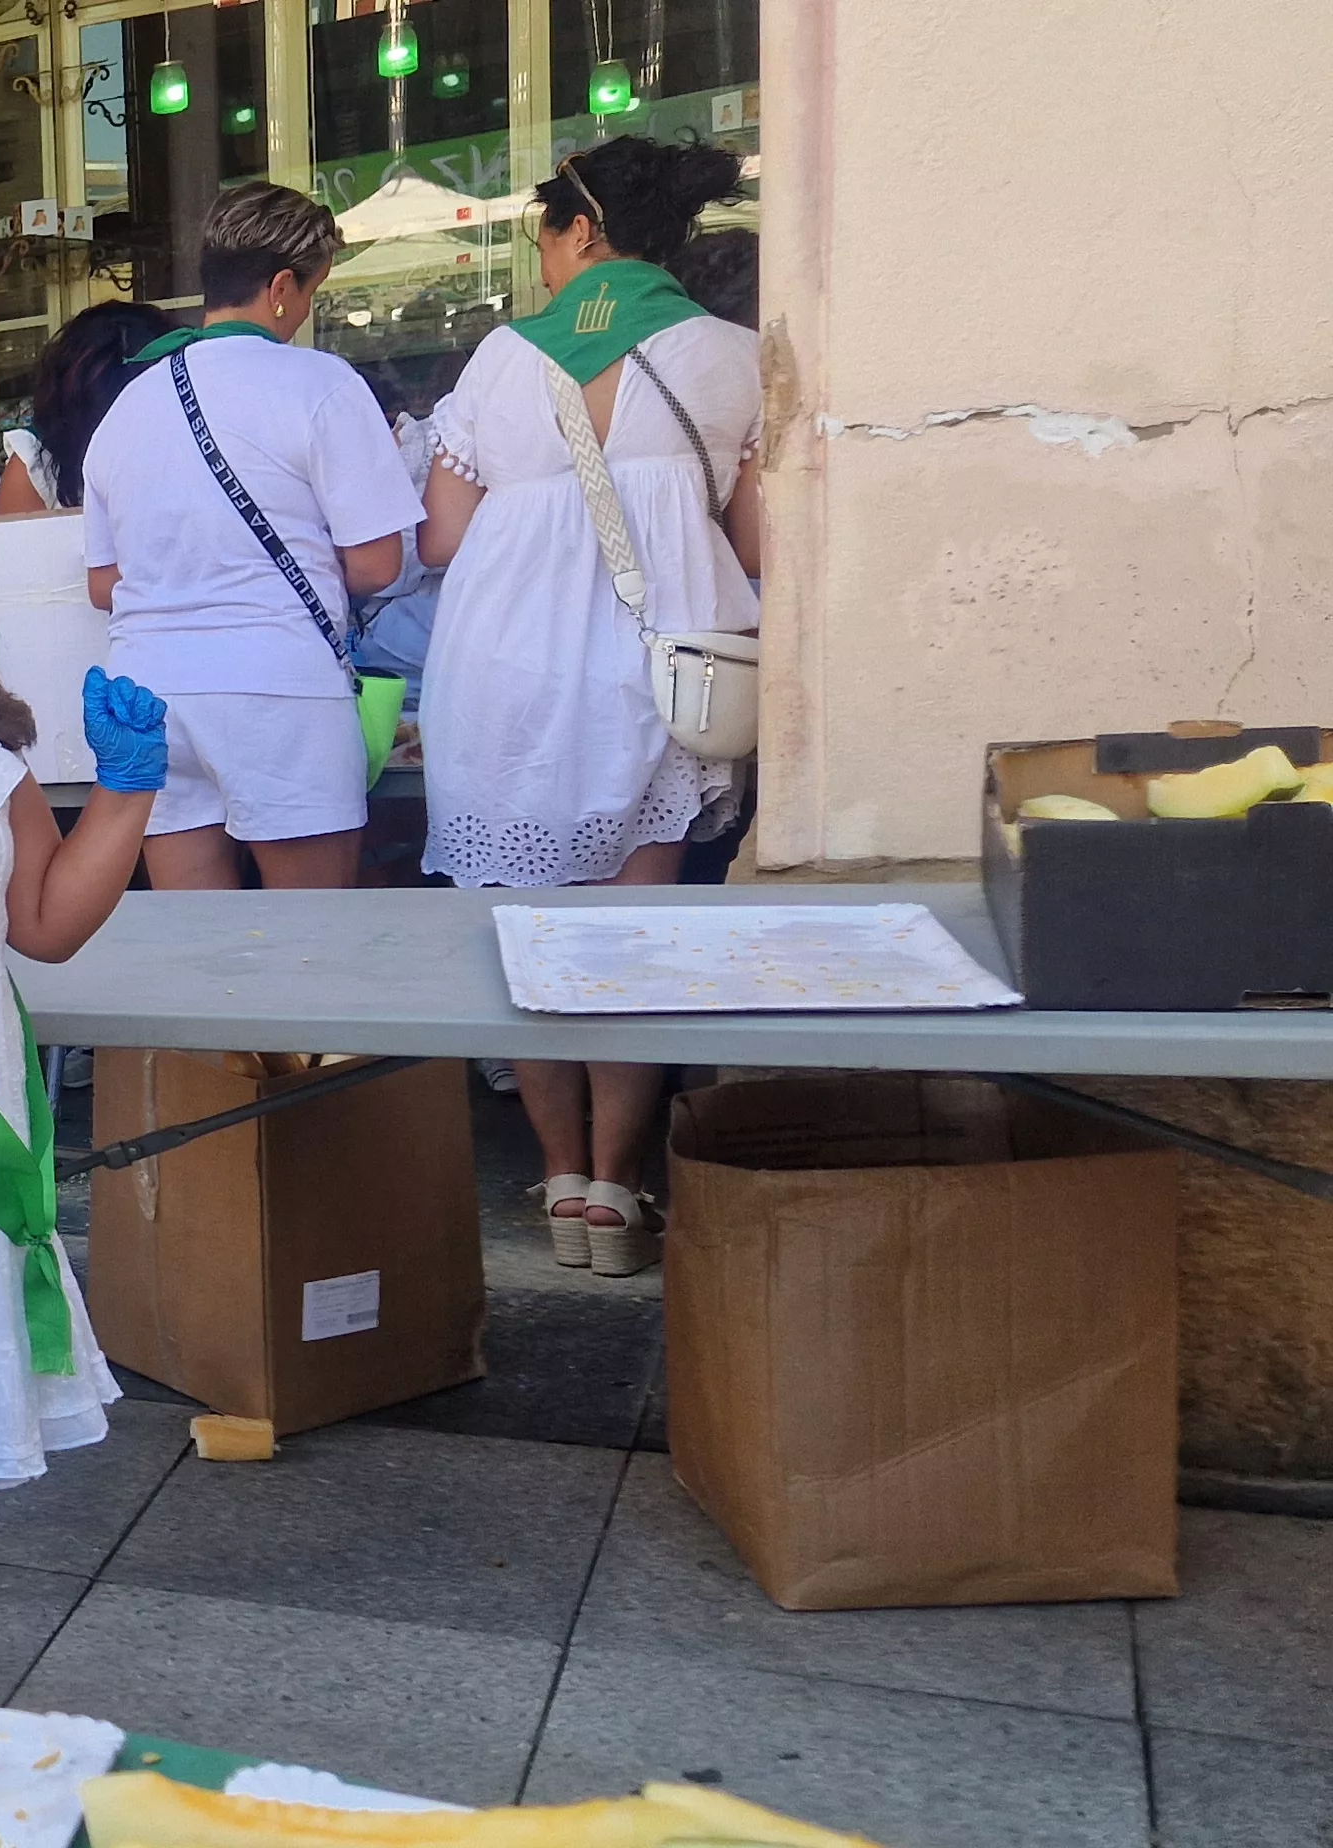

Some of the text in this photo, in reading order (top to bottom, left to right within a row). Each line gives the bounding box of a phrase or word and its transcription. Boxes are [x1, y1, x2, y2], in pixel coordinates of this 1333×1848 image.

[171, 354, 197, 413] FLEURS
[191, 415, 215, 454] DES
[211, 459, 252, 510] FILLE
[251, 513, 274, 541] LA
[277, 552, 333, 627] FLEURS
